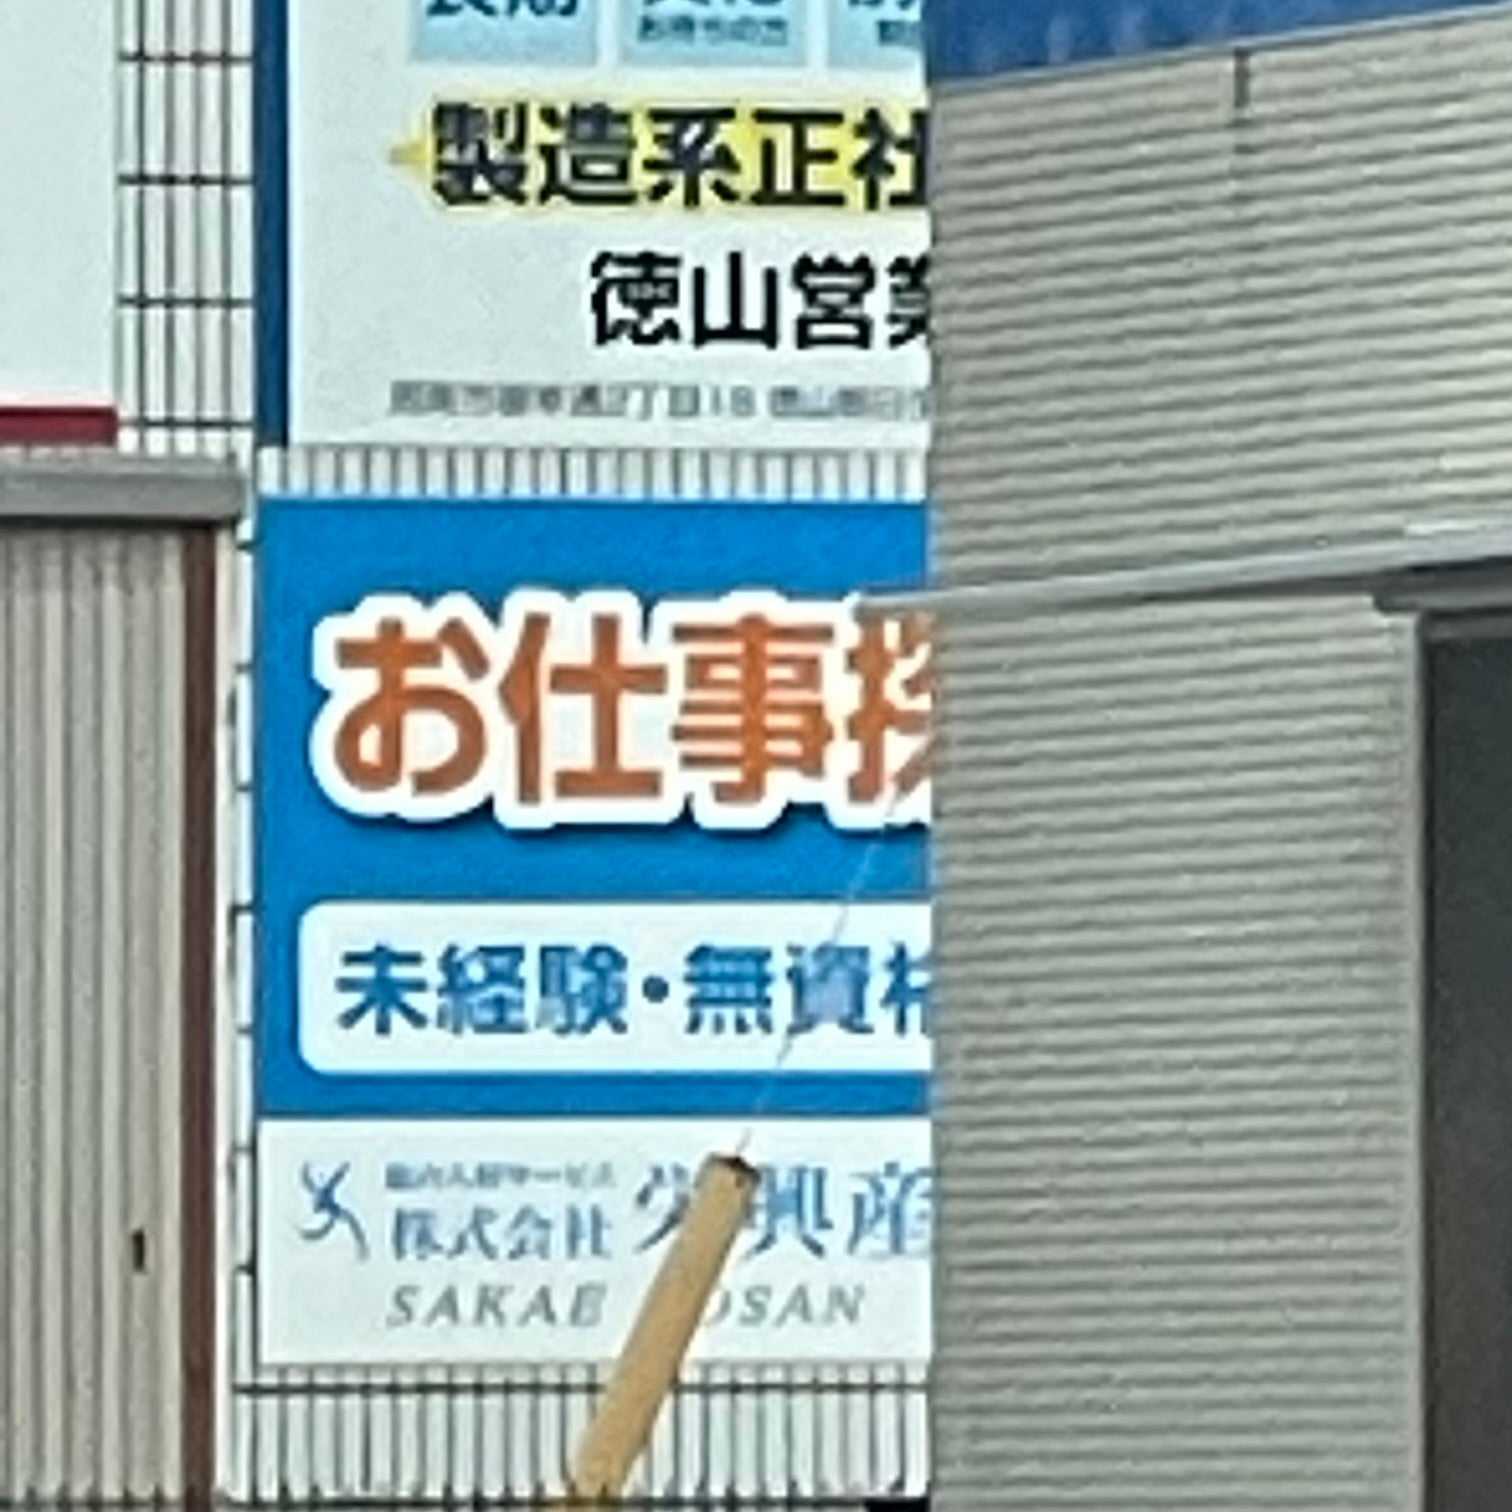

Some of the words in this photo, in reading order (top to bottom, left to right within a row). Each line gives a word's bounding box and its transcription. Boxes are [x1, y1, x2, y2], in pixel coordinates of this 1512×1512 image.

[432, 102, 929, 211] 製造系正社
[390, 1204, 613, 1261] 株式会社
